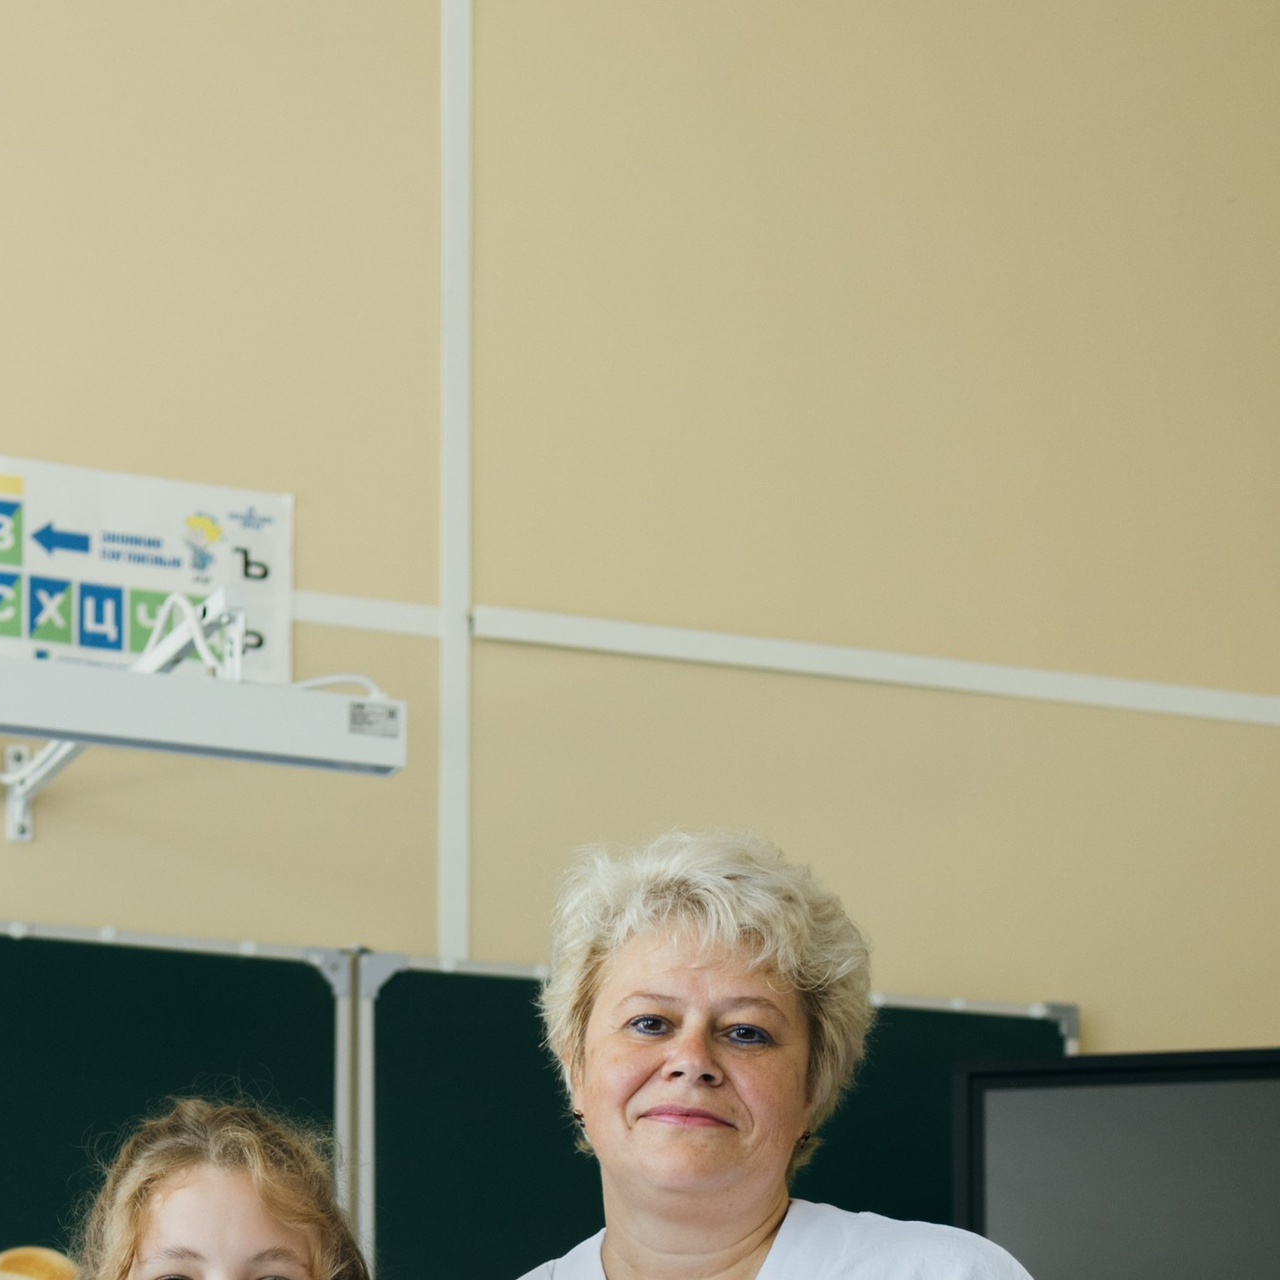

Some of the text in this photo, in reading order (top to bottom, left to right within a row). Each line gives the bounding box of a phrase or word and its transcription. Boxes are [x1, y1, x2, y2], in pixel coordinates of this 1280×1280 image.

[233, 545, 269, 581] Ъ
[35, 588, 67, 629] Х
[83, 595, 119, 644] Ц
